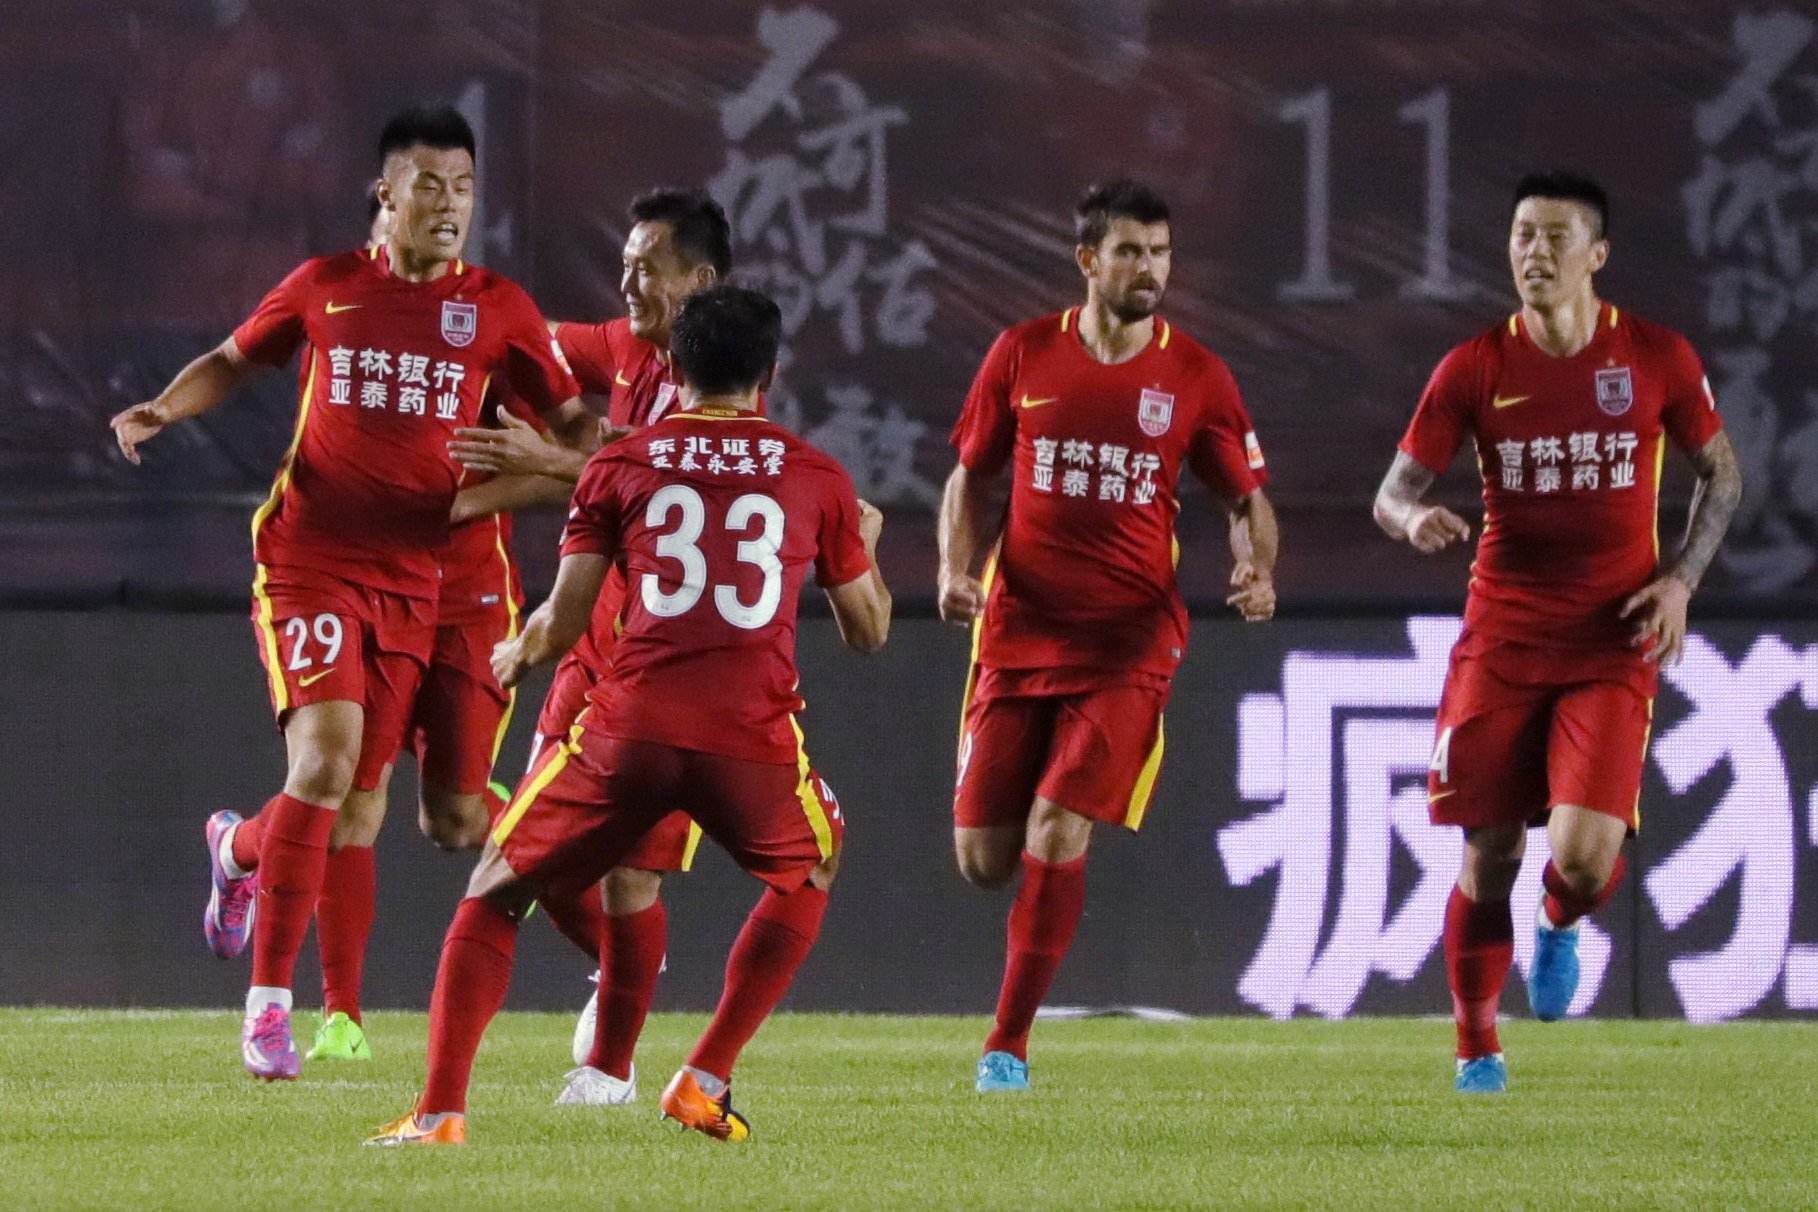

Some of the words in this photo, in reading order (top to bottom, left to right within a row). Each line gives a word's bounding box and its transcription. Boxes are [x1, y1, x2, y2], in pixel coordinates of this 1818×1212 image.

[328, 345, 466, 394] 吉林银行
[328, 378, 460, 420] 亚泰药业
[648, 436, 786, 456] 东北证券
[652, 452, 785, 476] 亚泰永安堂
[1033, 435, 1161, 481] 吉林银行
[1496, 431, 1639, 467] 吉林银行
[1032, 463, 1157, 505] 亚泰药业
[1502, 461, 1636, 492] 亚泰药业
[641, 484, 785, 630] 33
[286, 613, 343, 671] 29
